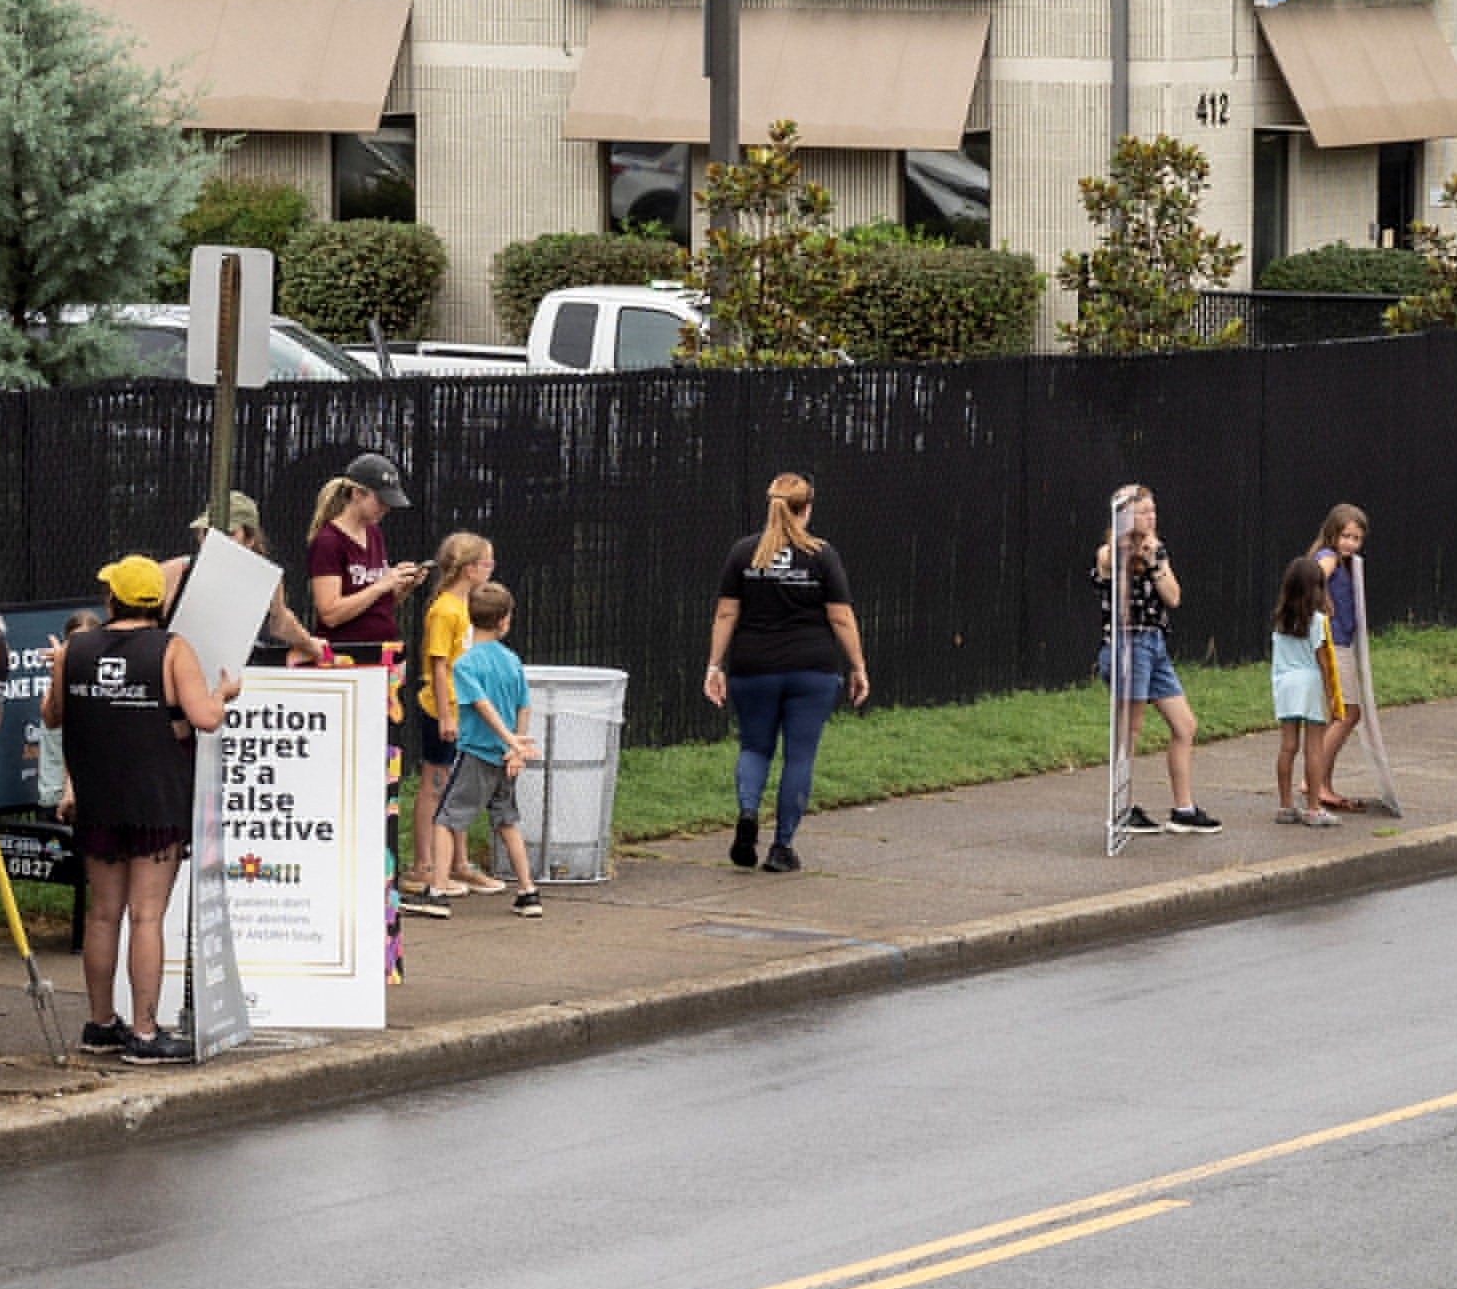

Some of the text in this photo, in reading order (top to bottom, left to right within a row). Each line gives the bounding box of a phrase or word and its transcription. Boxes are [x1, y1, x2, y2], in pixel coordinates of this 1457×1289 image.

[1195, 93, 1231, 124] 412
[226, 703, 327, 731] ortion
[222, 736, 310, 764] egret
[257, 765, 275, 785] a
[223, 786, 295, 813] alse
